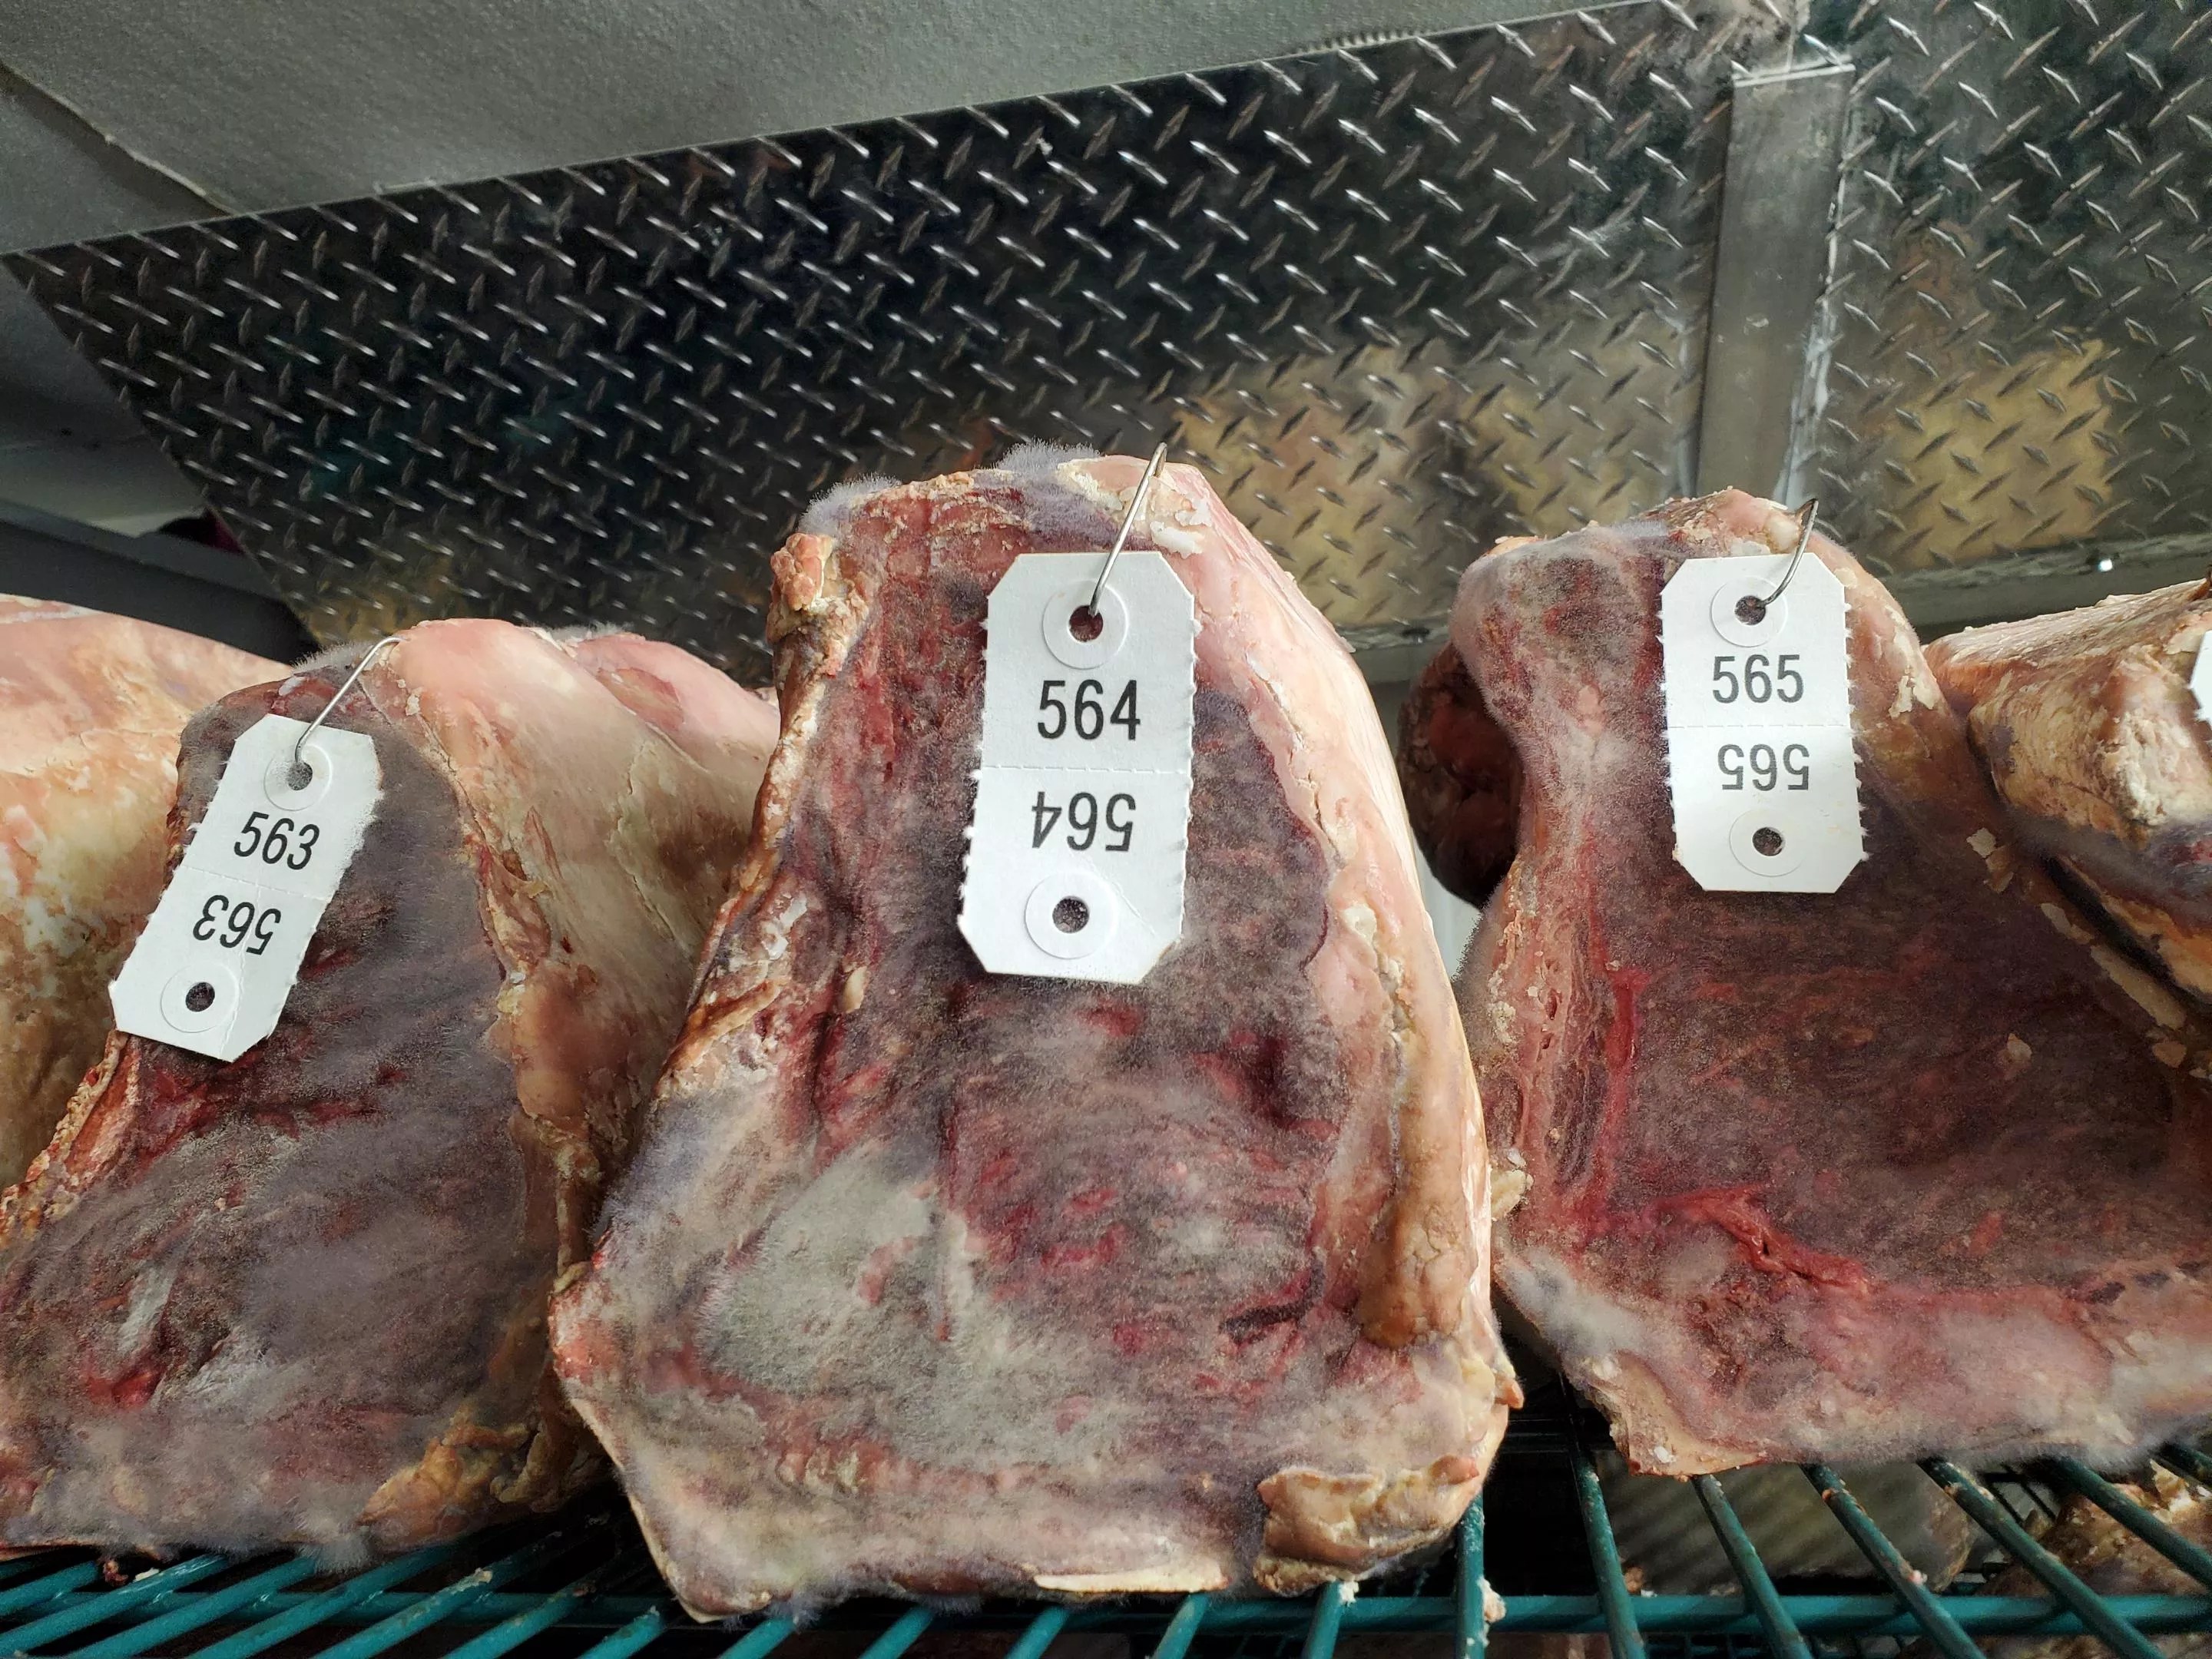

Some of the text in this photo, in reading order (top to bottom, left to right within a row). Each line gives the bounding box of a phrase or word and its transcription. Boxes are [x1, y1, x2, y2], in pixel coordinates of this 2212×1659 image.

[1713, 654, 1805, 704] 565
[1037, 679, 1141, 741] 564
[1717, 743, 1810, 792] 565
[233, 811, 321, 870] 563
[1031, 790, 1137, 853] 564
[192, 894, 283, 956] 563
